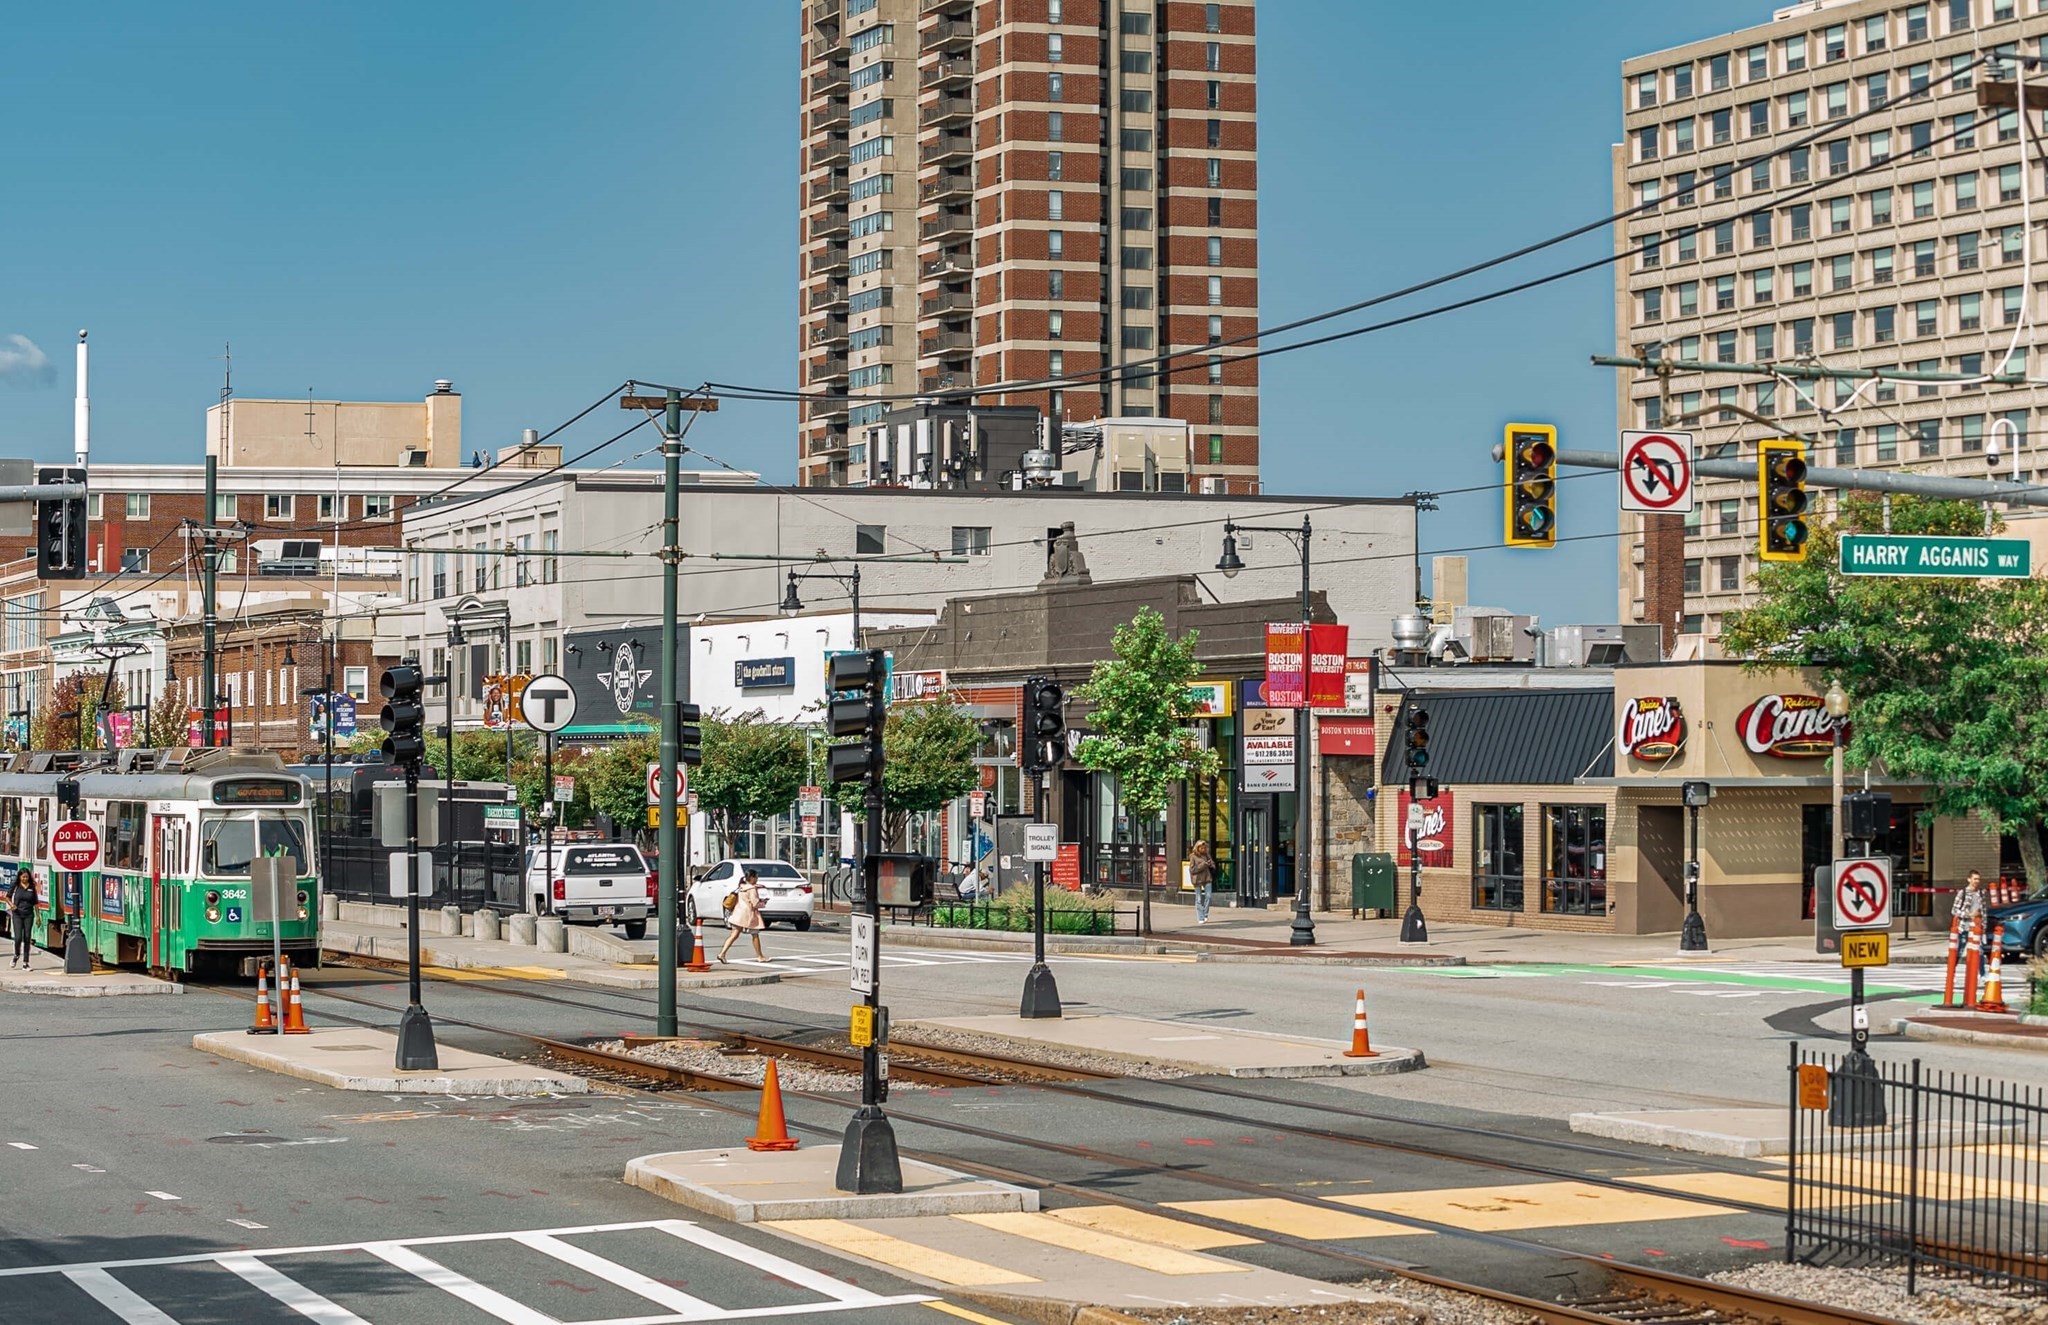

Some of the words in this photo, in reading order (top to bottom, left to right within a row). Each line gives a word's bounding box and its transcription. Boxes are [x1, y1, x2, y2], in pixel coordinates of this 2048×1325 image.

[1853, 545, 1909, 566] HARRY
[1919, 546, 1989, 567] AGGANIS
[1998, 555, 2020, 567] WAY
[1269, 626, 1303, 634] UNIVERSITY
[1268, 653, 1303, 665] BOSTON
[1311, 654, 1345, 666] BOSTON
[743, 666, 751, 677] the
[752, 664, 772, 680] goodwill
[772, 665, 785, 676] store
[1268, 665, 1303, 673] UNIVERSITY
[1311, 665, 1344, 674] UNIVERSITY
[1269, 691, 1303, 702] BOSTON
[530, 690, 569, 723] T
[1784, 697, 1821, 710] Raising
[1618, 697, 1675, 755] Cane's
[1746, 695, 1850, 753] Cane
[1321, 726, 1342, 735] BOSTON
[1343, 726, 1374, 735] UNIVERSITY
[1246, 741, 1293, 749] AVAILABLE
[58, 831, 71, 840] DO
[75, 831, 93, 840] NOT
[62, 852, 90, 862] ENTER
[222, 889, 247, 899] 3642
[858, 922, 866, 939] NO
[855, 945, 869, 961] TURN
[1848, 942, 1880, 959] NEW
[852, 966, 859, 982] ON
[861, 967, 870, 984] RED
